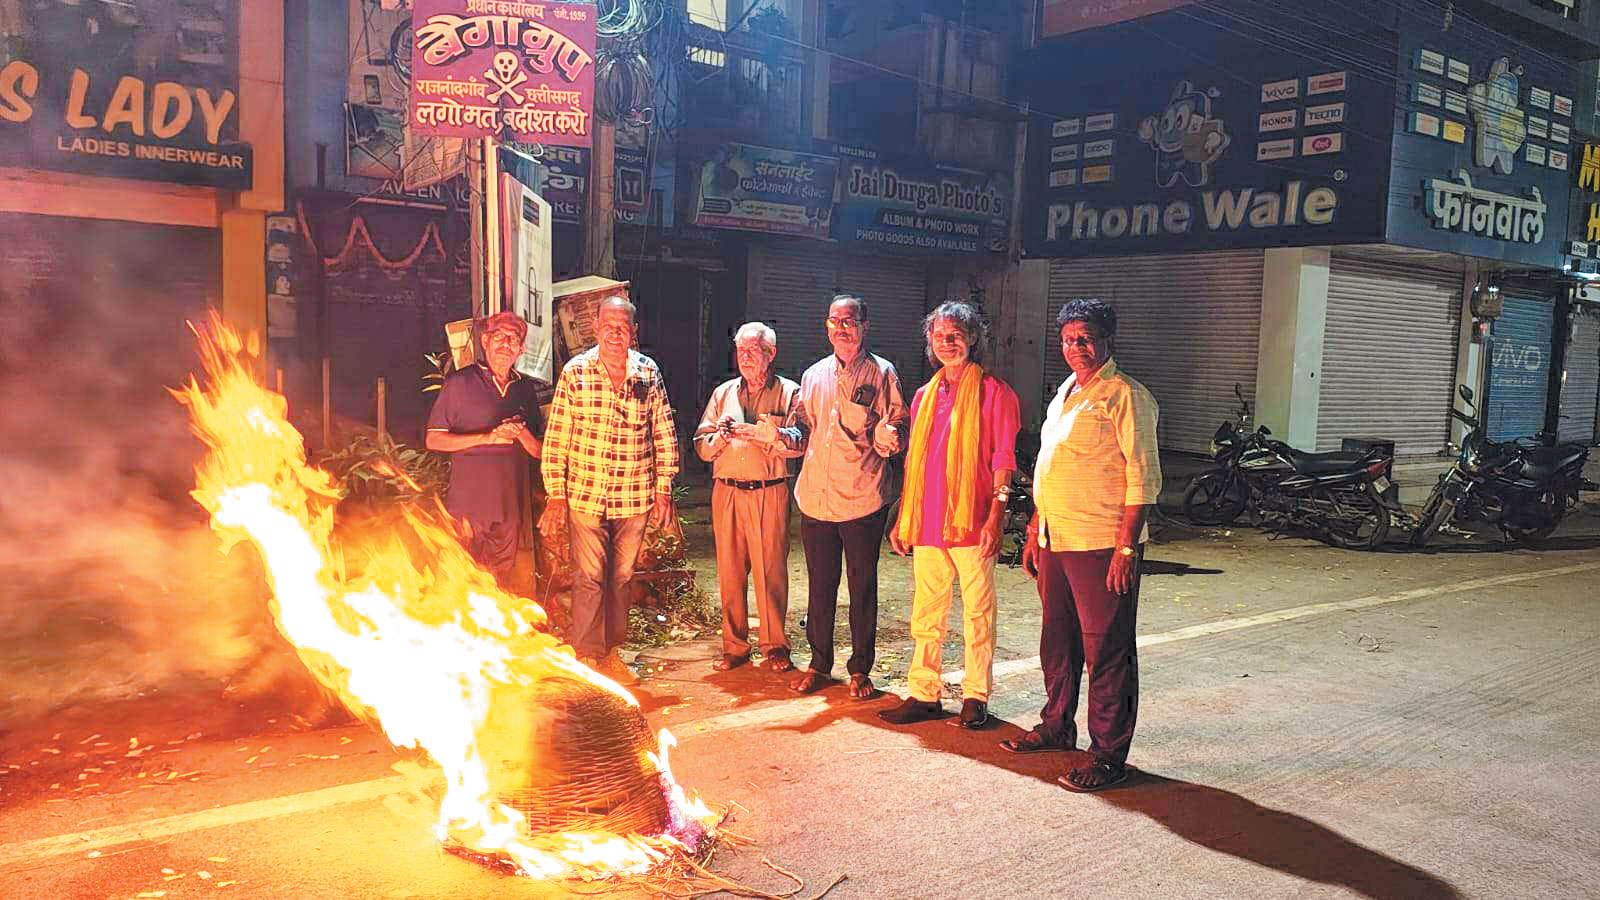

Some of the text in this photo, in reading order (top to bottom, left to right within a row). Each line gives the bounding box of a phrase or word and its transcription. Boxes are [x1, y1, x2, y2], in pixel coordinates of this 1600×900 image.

[66, 68, 235, 144] LADY
[556, 106, 588, 135] करो
[1308, 108, 1341, 122] TECNO
[1262, 116, 1293, 127] HONOR
[57, 136, 244, 169] LADIES INNERWEAR
[850, 167, 880, 197] Jai
[884, 173, 937, 212] Durga
[942, 183, 1002, 215] Photo's
[883, 213, 913, 228] ALBUM
[926, 219, 952, 232] PHOTO
[955, 222, 979, 235] WORK
[1047, 181, 1338, 241] Phone Wale
[856, 229, 884, 241] PHOTO
[886, 234, 914, 245] GOODS
[937, 239, 978, 251] AVAILABLE
